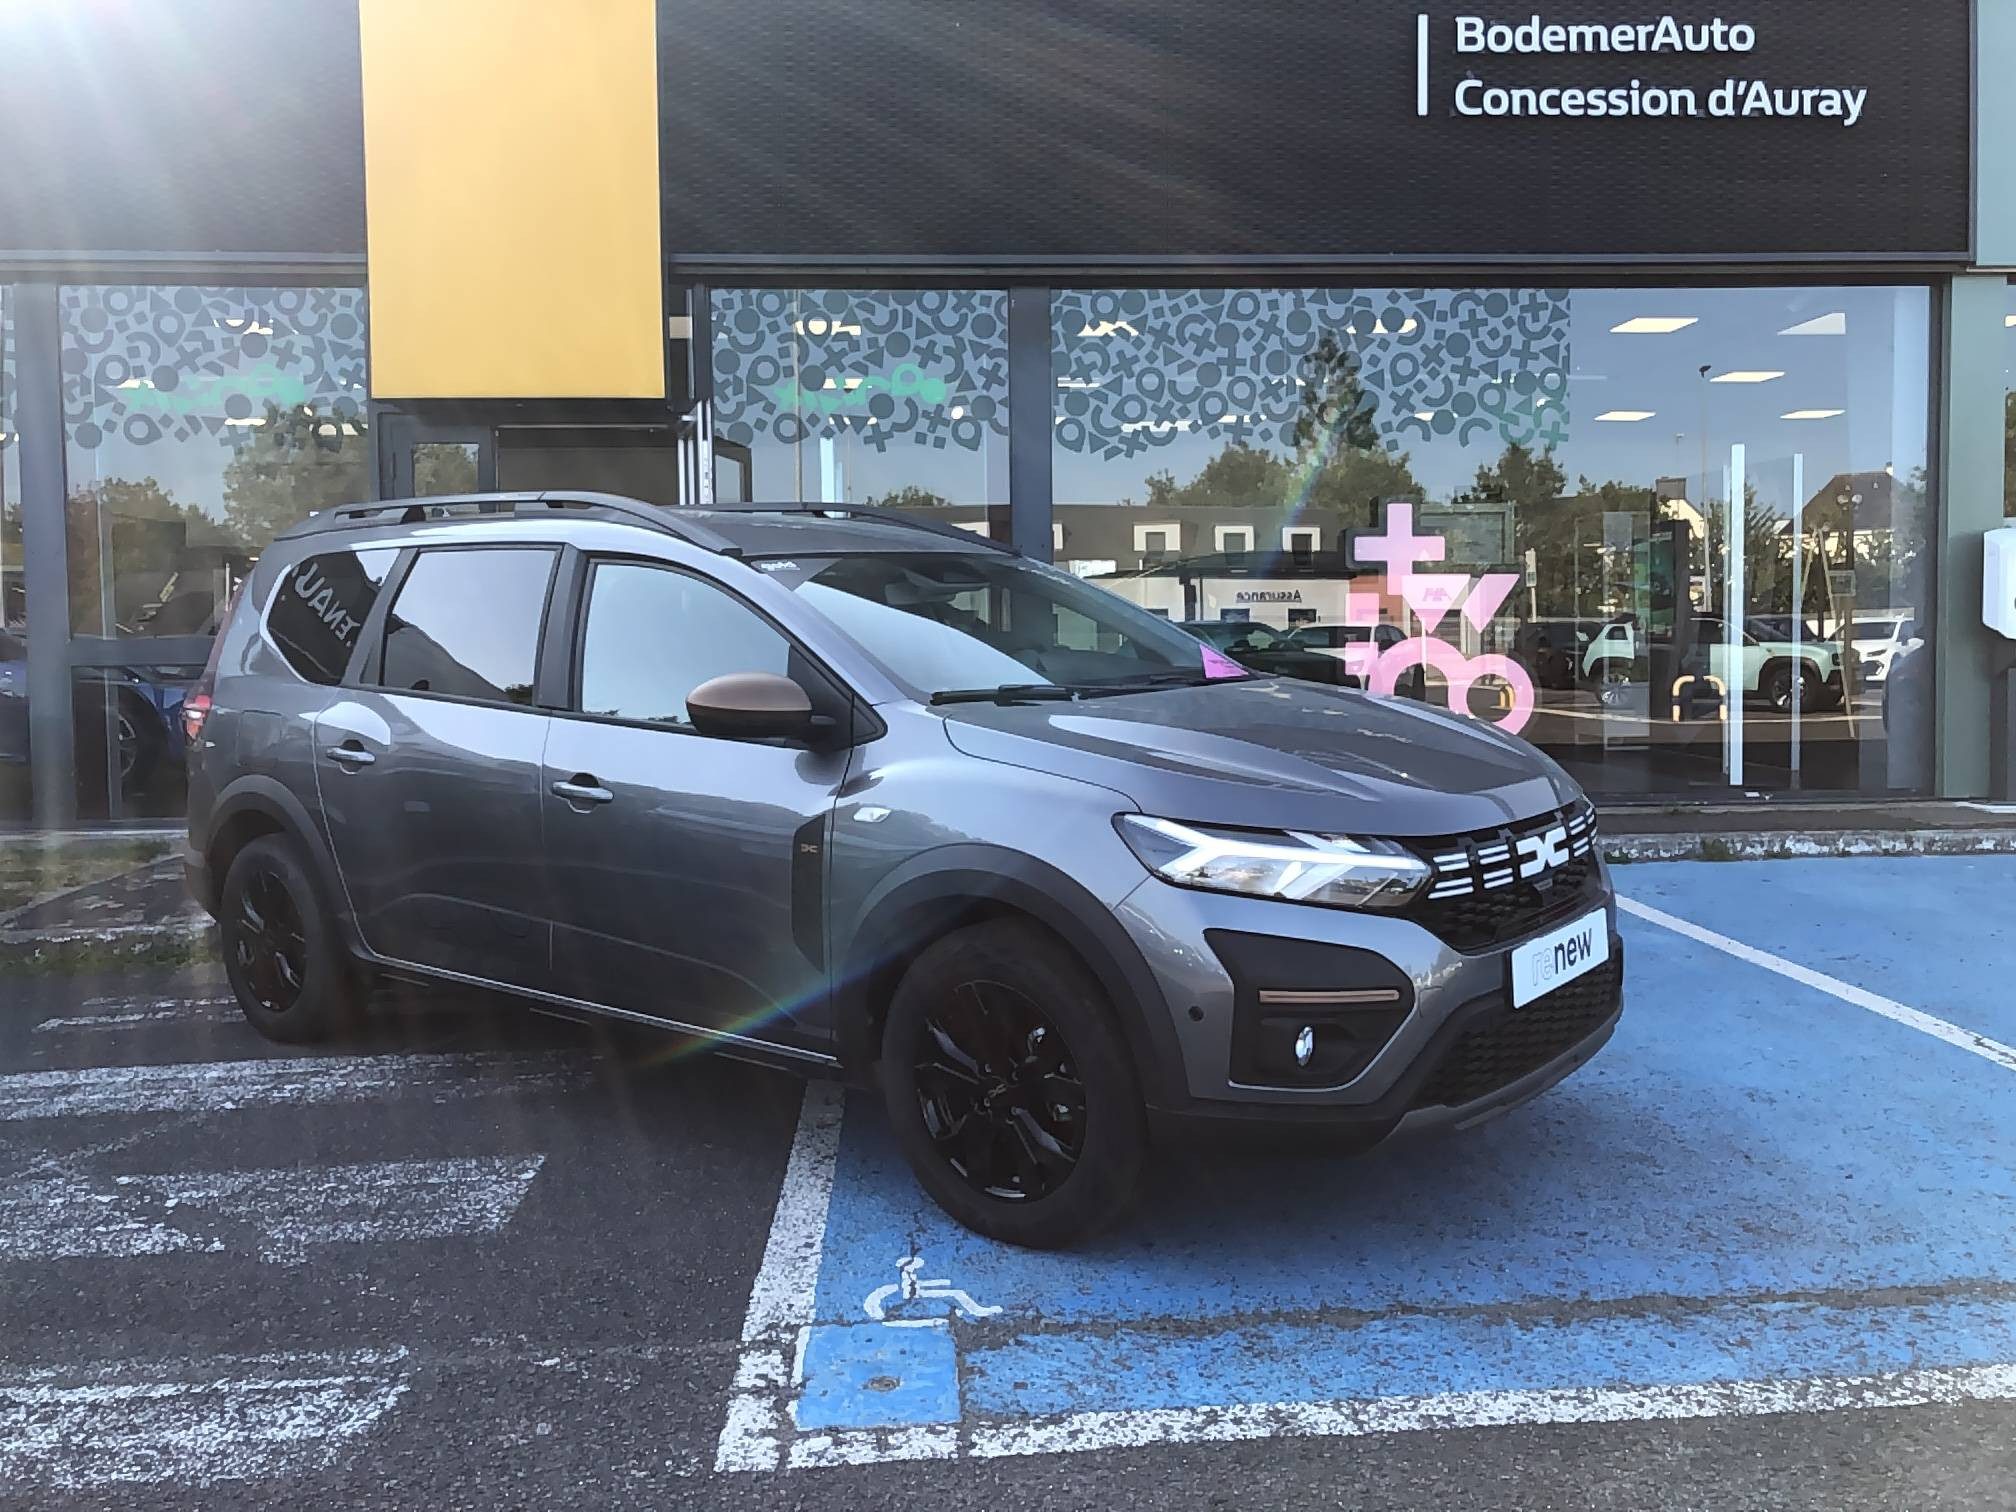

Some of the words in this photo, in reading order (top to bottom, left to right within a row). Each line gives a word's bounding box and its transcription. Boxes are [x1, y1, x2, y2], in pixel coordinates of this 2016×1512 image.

[1455, 15, 1755, 52] BodemerAuto
[1455, 79, 1696, 116] Concession
[1708, 79, 1867, 126] d'Auray
[1532, 927, 1592, 987] renew
